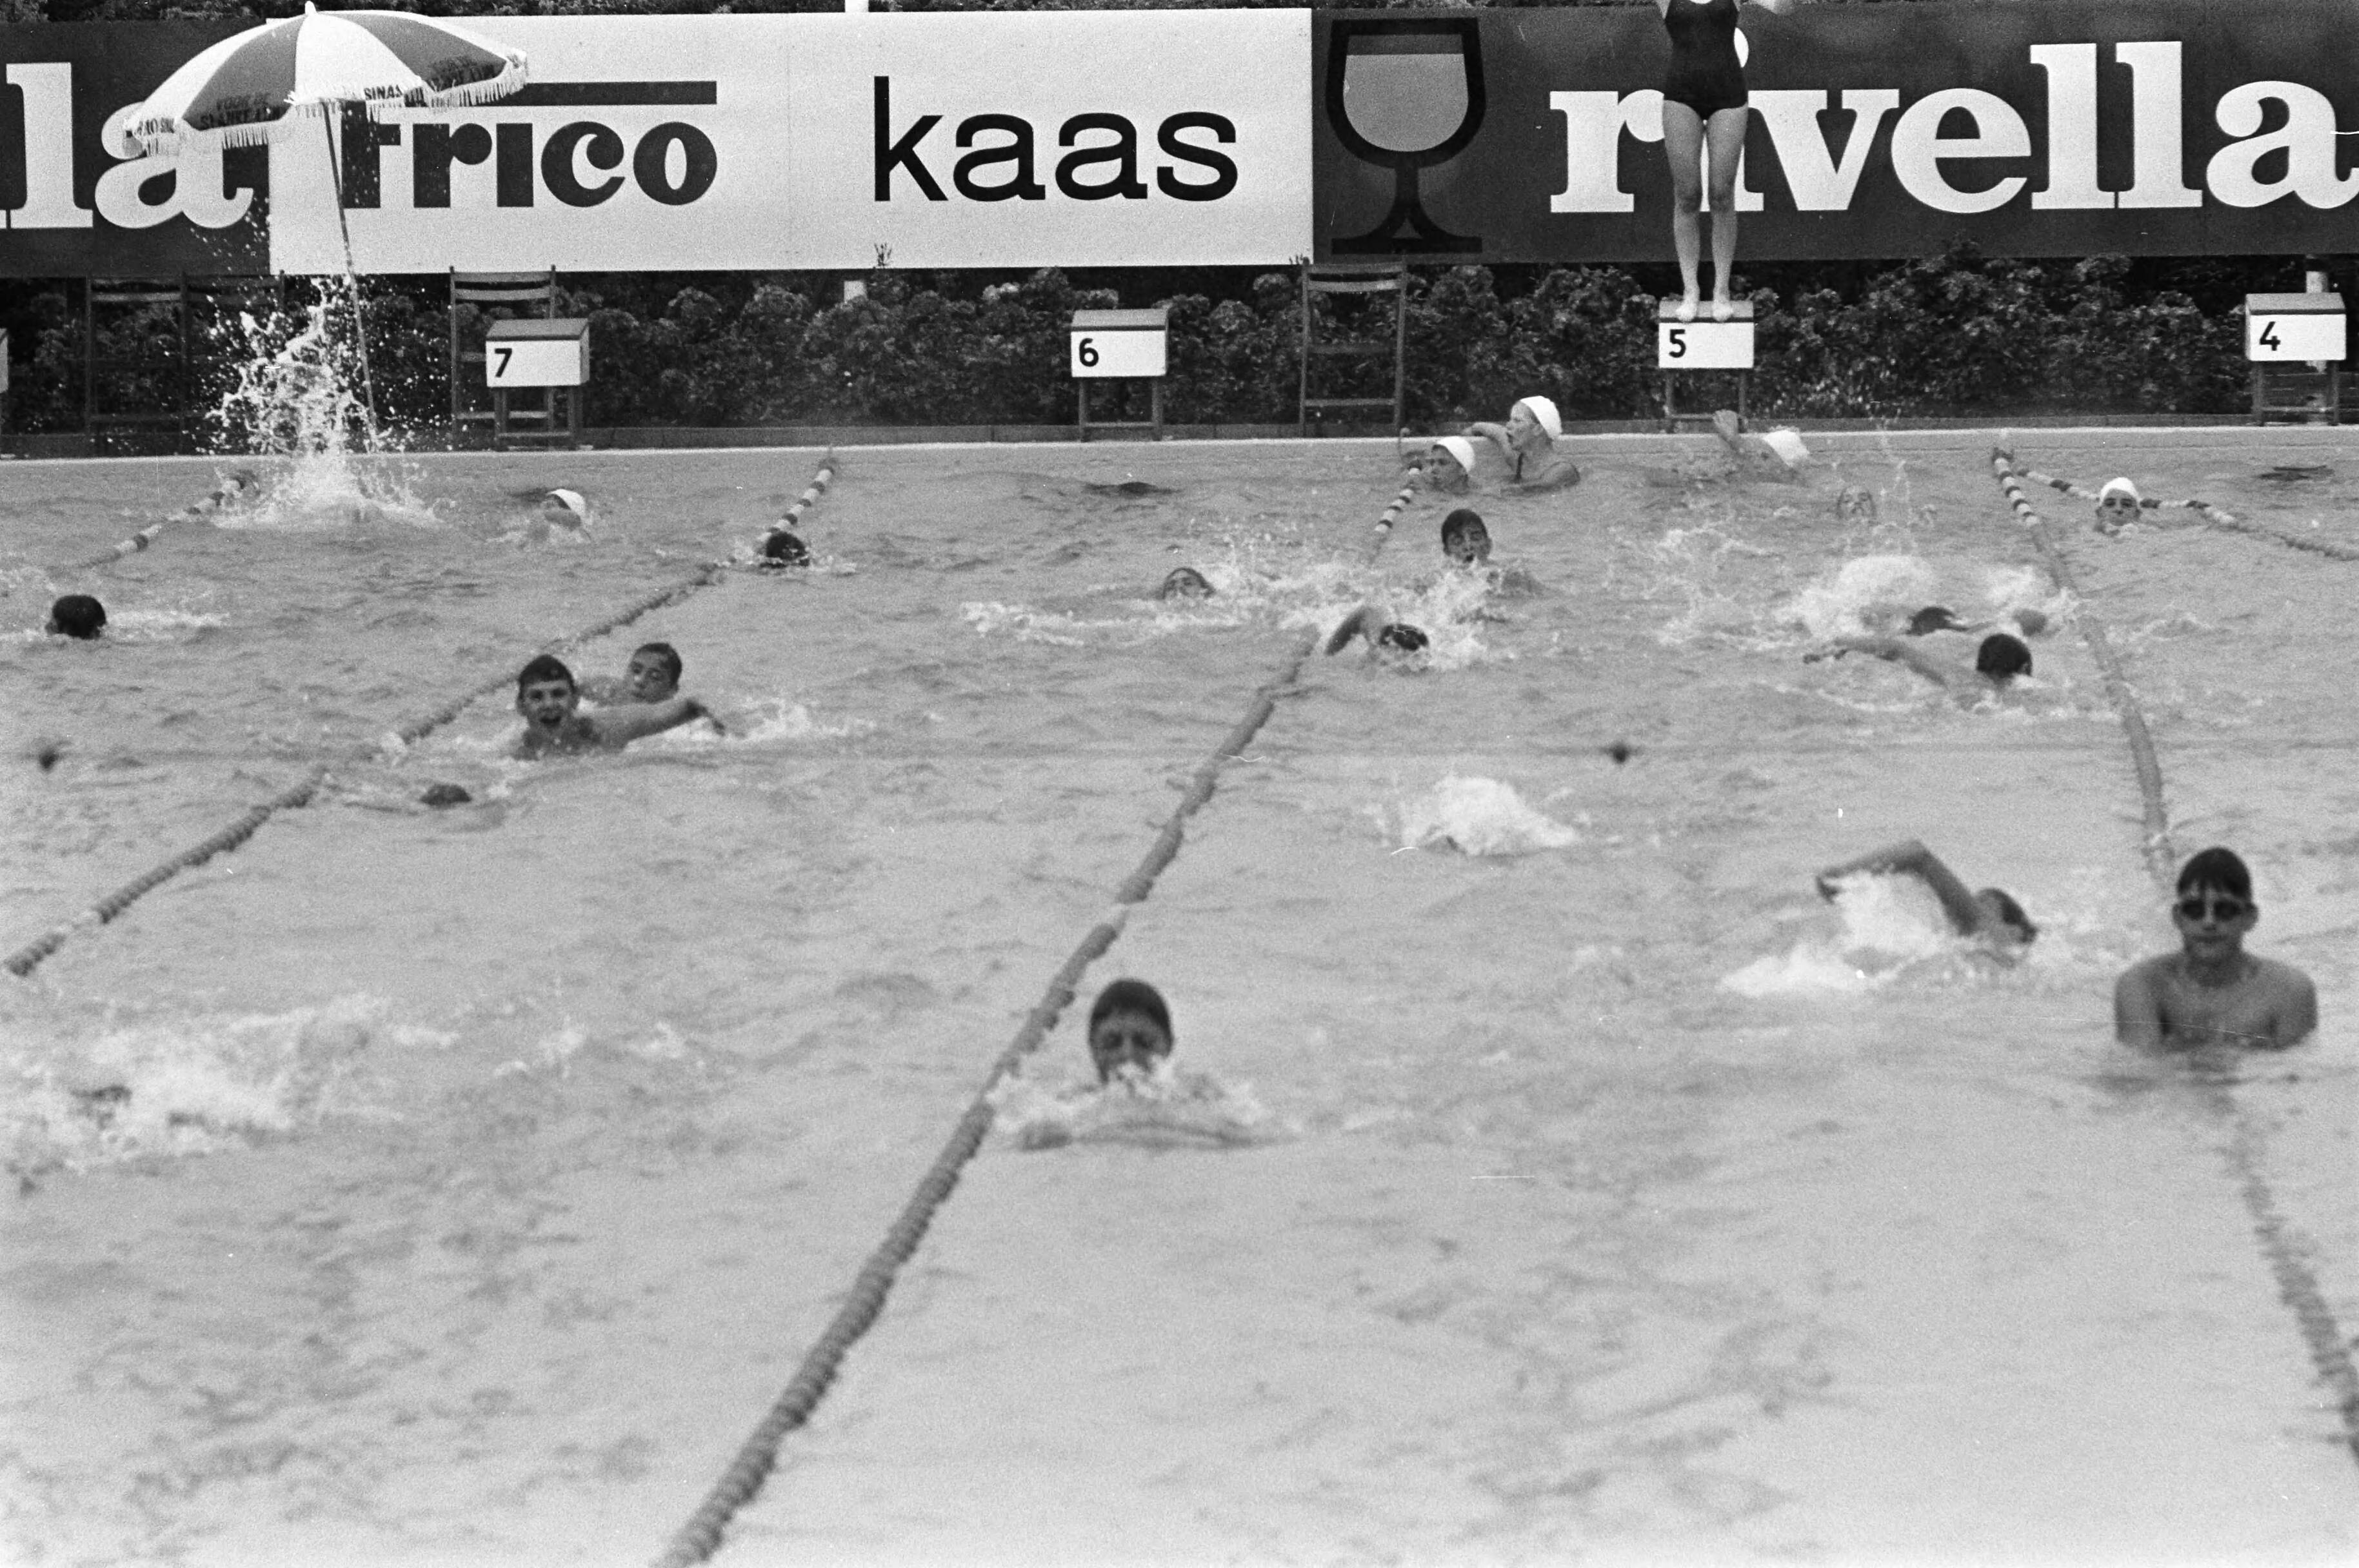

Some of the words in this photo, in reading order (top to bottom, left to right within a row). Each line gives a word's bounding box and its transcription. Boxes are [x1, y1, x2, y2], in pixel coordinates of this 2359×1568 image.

[1549, 28, 2359, 213] rvella
[0, 63, 254, 229] la
[874, 75, 1238, 202] kaas
[1669, 329, 1686, 358] 5
[2259, 321, 2280, 352] 4
[494, 348, 512, 378] 7
[1079, 338, 1099, 367] 6
